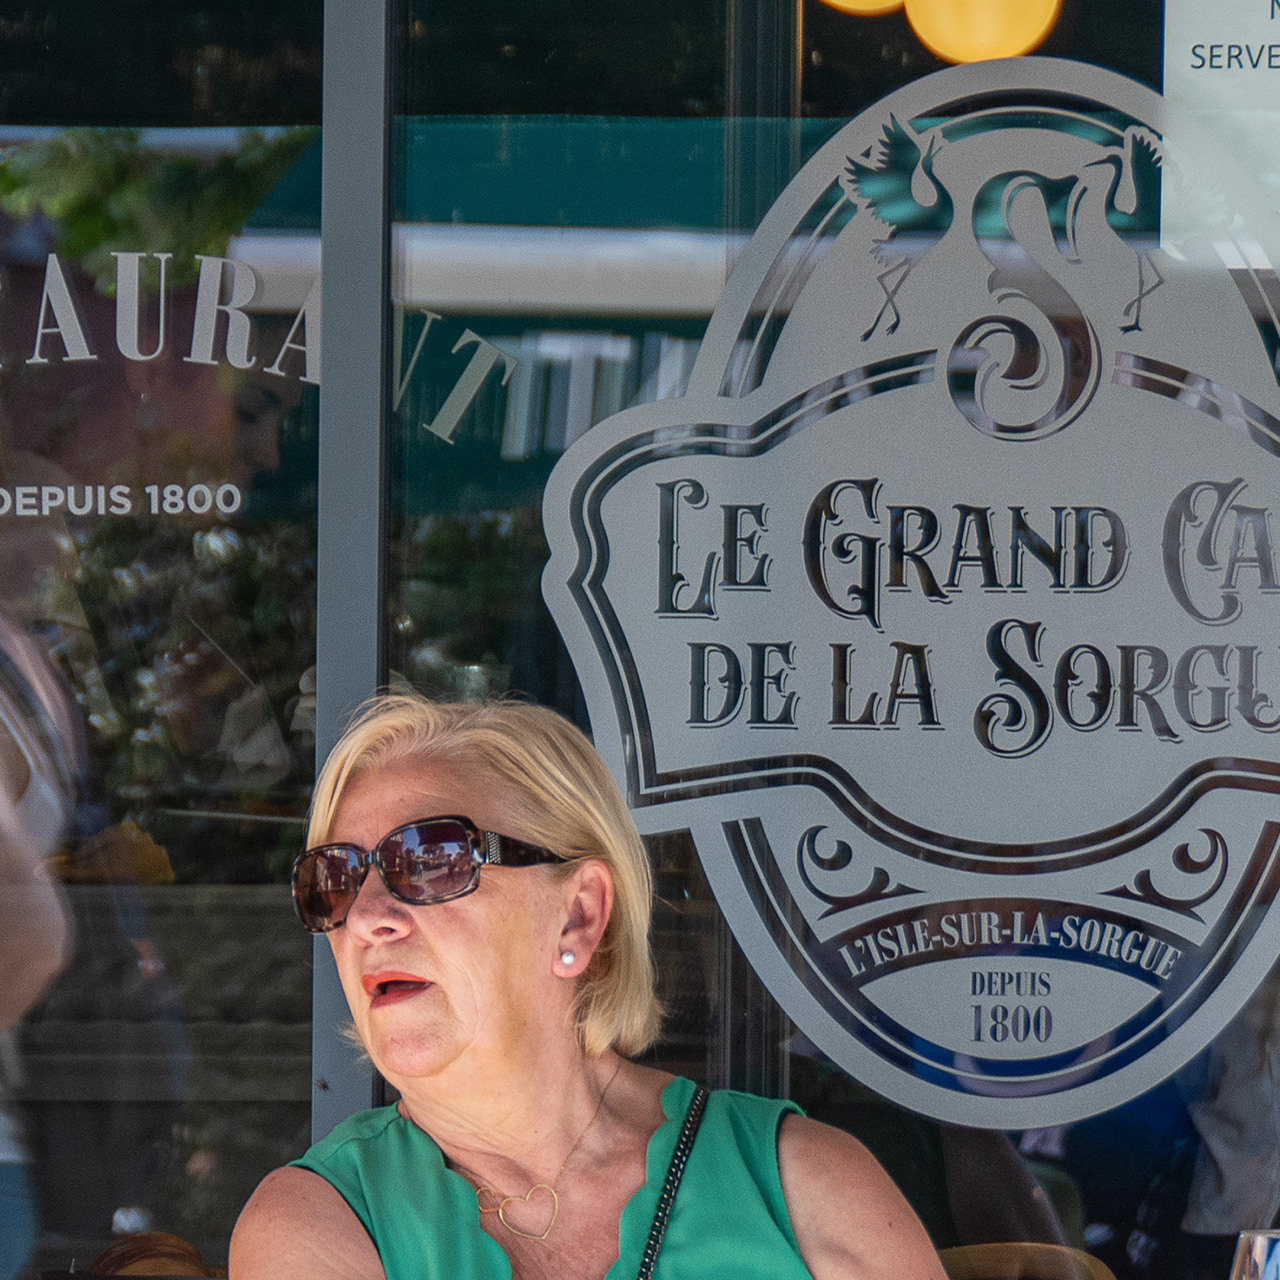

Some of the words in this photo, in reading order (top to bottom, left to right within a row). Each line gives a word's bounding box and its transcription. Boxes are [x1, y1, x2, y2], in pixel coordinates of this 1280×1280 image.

[144, 485, 242, 517] 1800
[970, 971, 1052, 998] DEPUIS
[970, 1003, 1053, 1044] 1800
